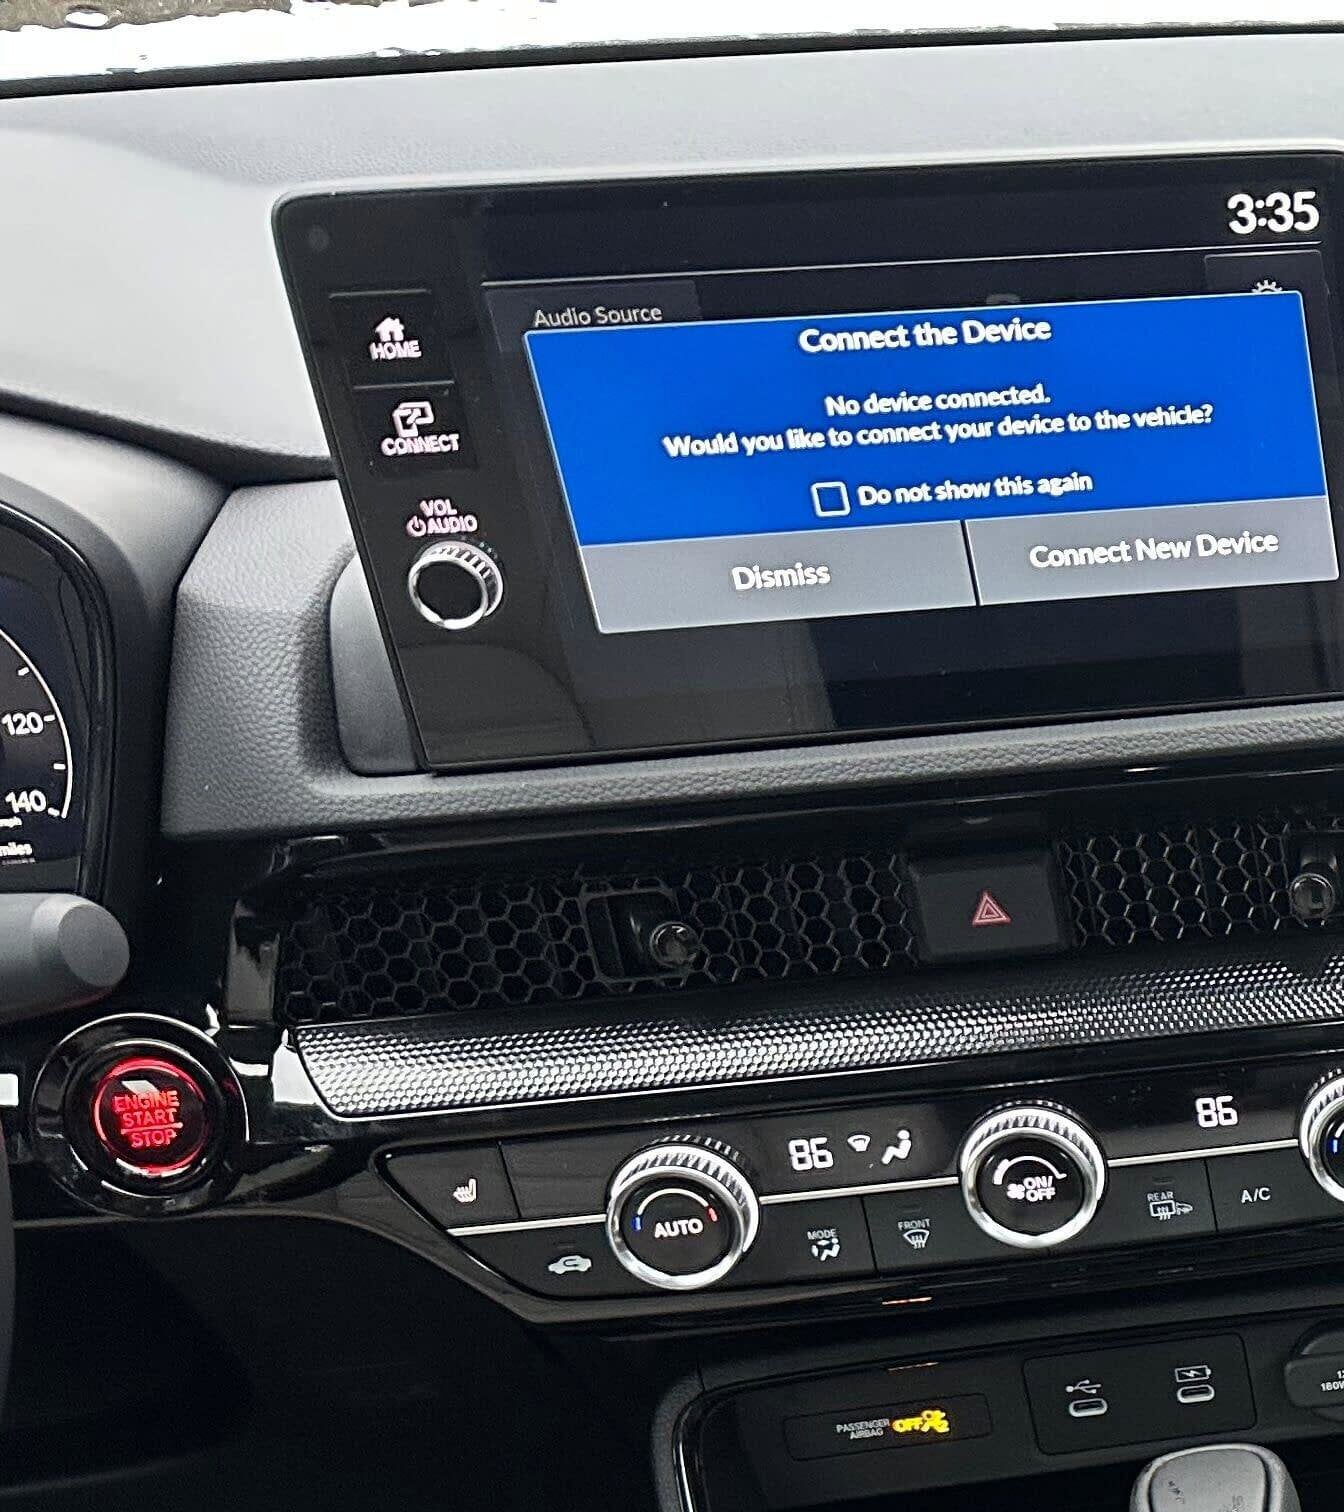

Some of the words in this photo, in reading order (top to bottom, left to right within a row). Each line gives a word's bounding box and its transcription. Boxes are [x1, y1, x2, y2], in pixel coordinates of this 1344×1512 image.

[1227, 190, 1320, 234] 3:35
[533, 307, 591, 327] Audio
[595, 305, 663, 325] Source
[798, 325, 911, 352] Connect
[913, 321, 958, 347] the
[961, 317, 1052, 344] Device
[370, 340, 422, 360] HOME
[824, 395, 860, 417] No
[863, 391, 933, 414] device
[935, 383, 1051, 410] connected.
[662, 431, 739, 457] Would
[741, 433, 784, 456] you
[786, 428, 825, 449] like
[828, 427, 853, 447] to
[856, 421, 942, 445] connect
[945, 420, 994, 443] your
[997, 414, 1065, 437] device
[1068, 412, 1092, 432] to
[1094, 409, 1131, 430] the
[1132, 404, 1214, 427] vehicle?
[381, 433, 459, 457] CONNECT
[857, 486, 891, 506] Do
[895, 483, 932, 504] not
[935, 480, 991, 500] show
[994, 476, 1034, 496] this
[1037, 472, 1093, 496] again
[420, 498, 457, 517] VOL
[426, 515, 478, 535] AUDIO
[1029, 540, 1132, 568] Connect
[1135, 537, 1192, 561] New
[1196, 530, 1279, 557] Device
[731, 562, 831, 591] Dismiss
[2, 711, 44, 736] 120
[5, 789, 47, 814] 140
[113, 1090, 180, 1113] ENGINE
[1195, 1095, 1238, 1128] 86
[122, 1108, 177, 1128] START
[131, 1129, 177, 1148] STOP
[788, 1136, 834, 1171] 86
[1025, 1187, 1056, 1202] OFF
[1147, 1191, 1174, 1201] REAR
[1241, 1187, 1271, 1204] A/C
[654, 1218, 704, 1238] AUTO
[807, 1229, 838, 1240] MODE
[898, 1218, 931, 1230] FRONT
[836, 1418, 890, 1433] PASSENGER
[850, 1427, 884, 1440] AIRBAG
